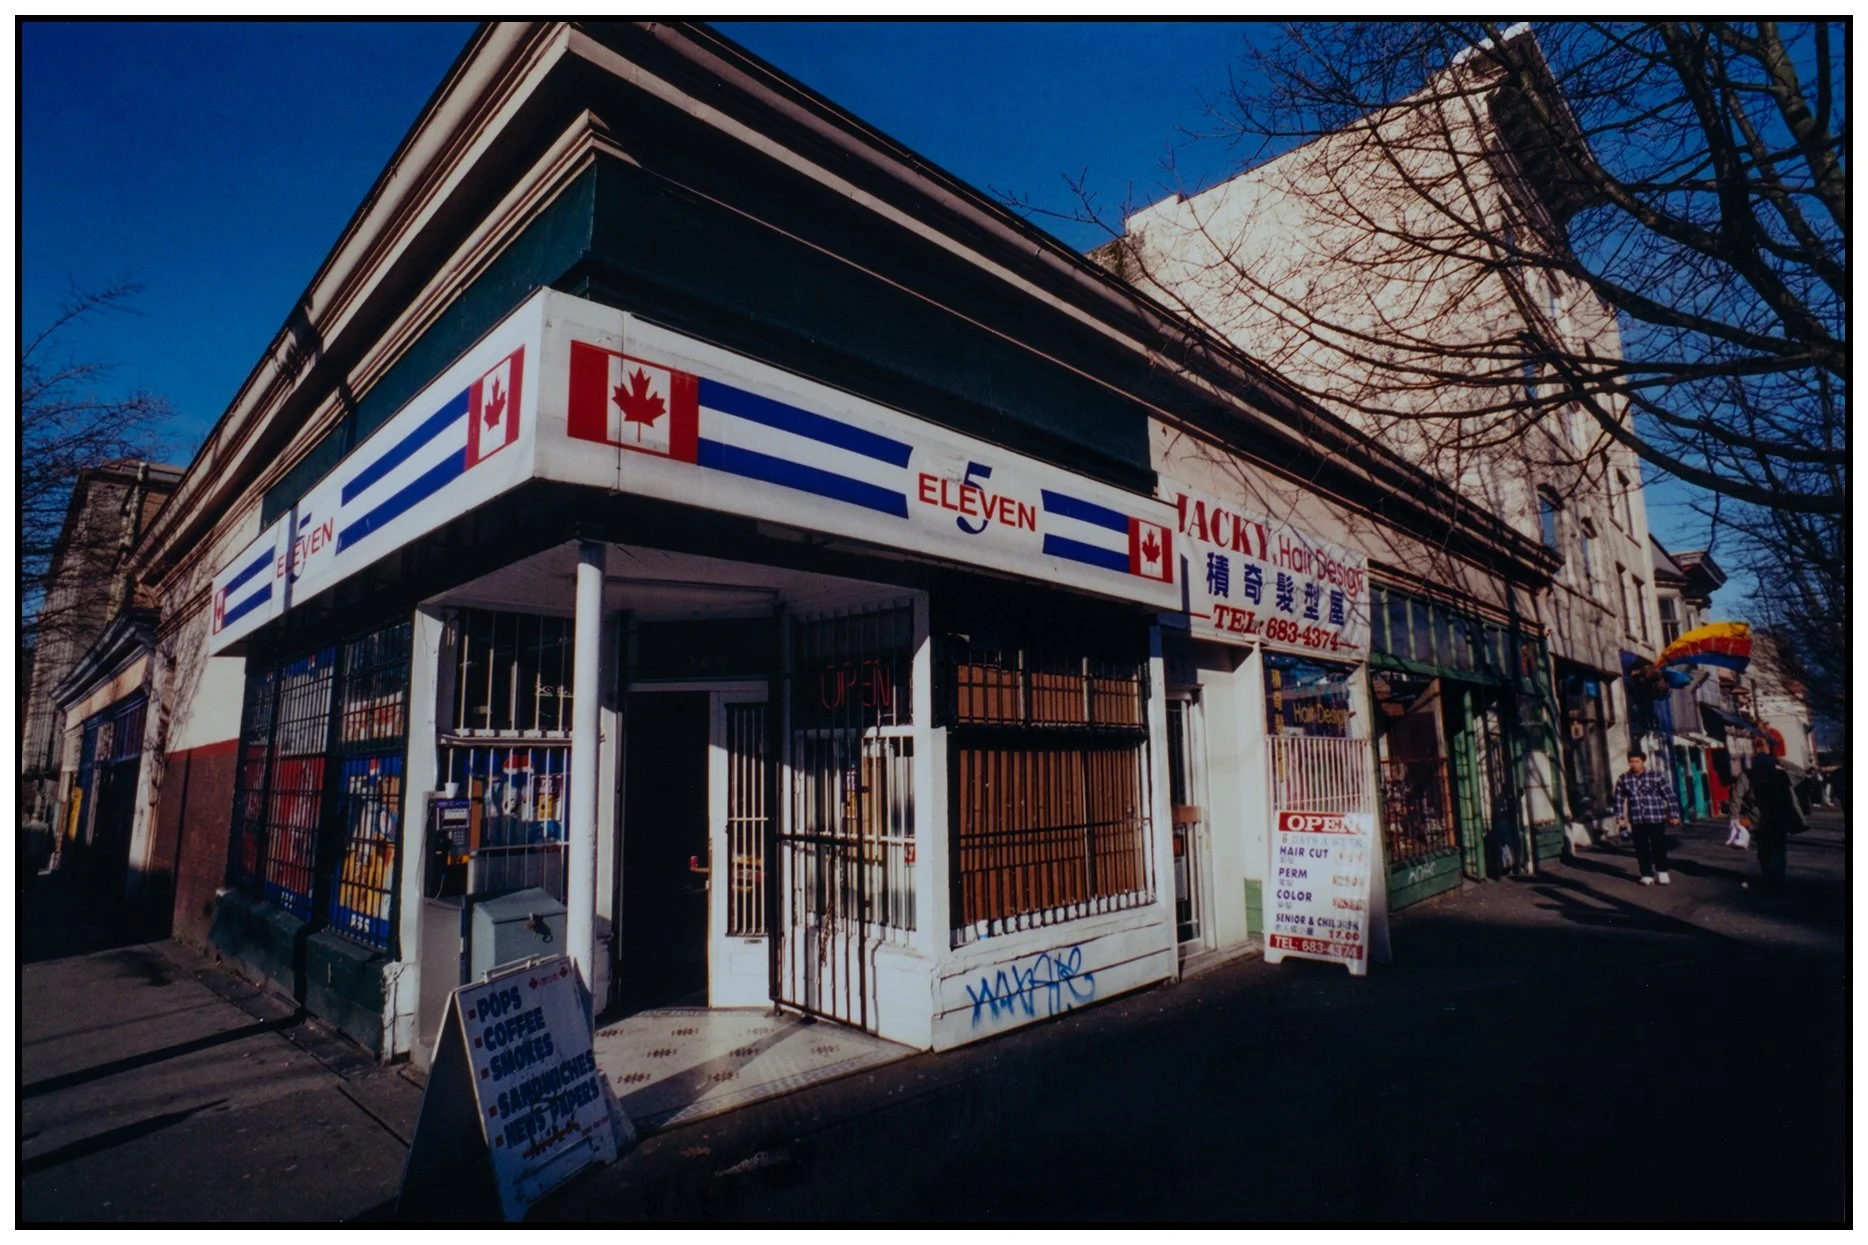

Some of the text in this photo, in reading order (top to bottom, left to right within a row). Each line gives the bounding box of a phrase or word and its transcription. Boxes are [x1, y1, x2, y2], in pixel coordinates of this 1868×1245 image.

[918, 472, 1036, 533] ELEVEN
[956, 460, 993, 535] 5
[276, 516, 334, 579] ELEVEN
[1278, 533, 1313, 576] Hair
[1315, 547, 1364, 598] Design
[1265, 616, 1340, 652] 683-4374
[821, 658, 892, 711] OPEN
[1278, 867, 1308, 879] PERM
[1279, 846, 1305, 857] HAIR
[1308, 848, 1329, 859] CUT
[1275, 912, 1306, 925] SENIOR
[1307, 916, 1315, 926] &
[1276, 889, 1312, 902] COLOR
[1273, 935, 1358, 958] TEL: 683-4374
[476, 986, 522, 1023] POPS
[483, 1006, 546, 1051] COFFEE
[489, 1032, 554, 1082] SMOKES
[497, 1049, 596, 1120] SANDWICHES
[503, 1105, 547, 1149] NEWS
[550, 1075, 600, 1124] PAPERS
